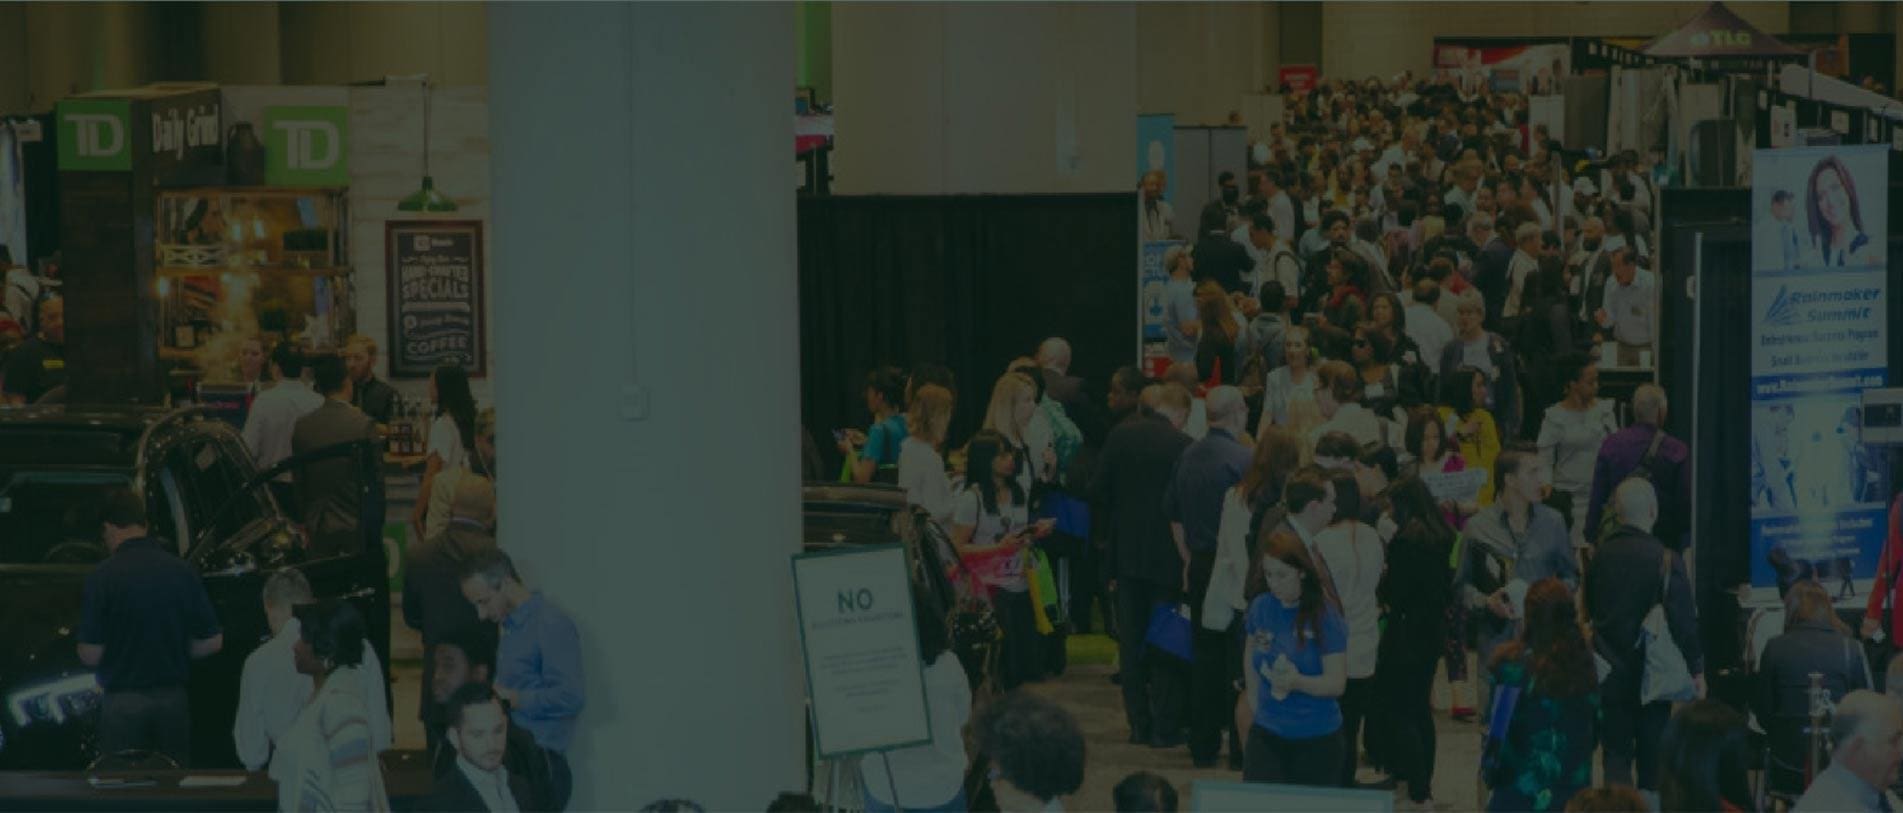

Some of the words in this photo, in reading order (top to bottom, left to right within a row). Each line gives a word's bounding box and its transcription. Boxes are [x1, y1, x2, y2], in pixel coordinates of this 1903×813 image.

[63, 113, 124, 157] TD
[151, 108, 185, 160] Daily
[186, 103, 219, 148] Grind
[272, 119, 340, 170] TD
[402, 279, 469, 299] SPECIALS
[1790, 287, 1881, 305] Rainmaker
[1807, 307, 1872, 322] Summit
[407, 336, 467, 354] COFFEE
[837, 587, 873, 613] NO
